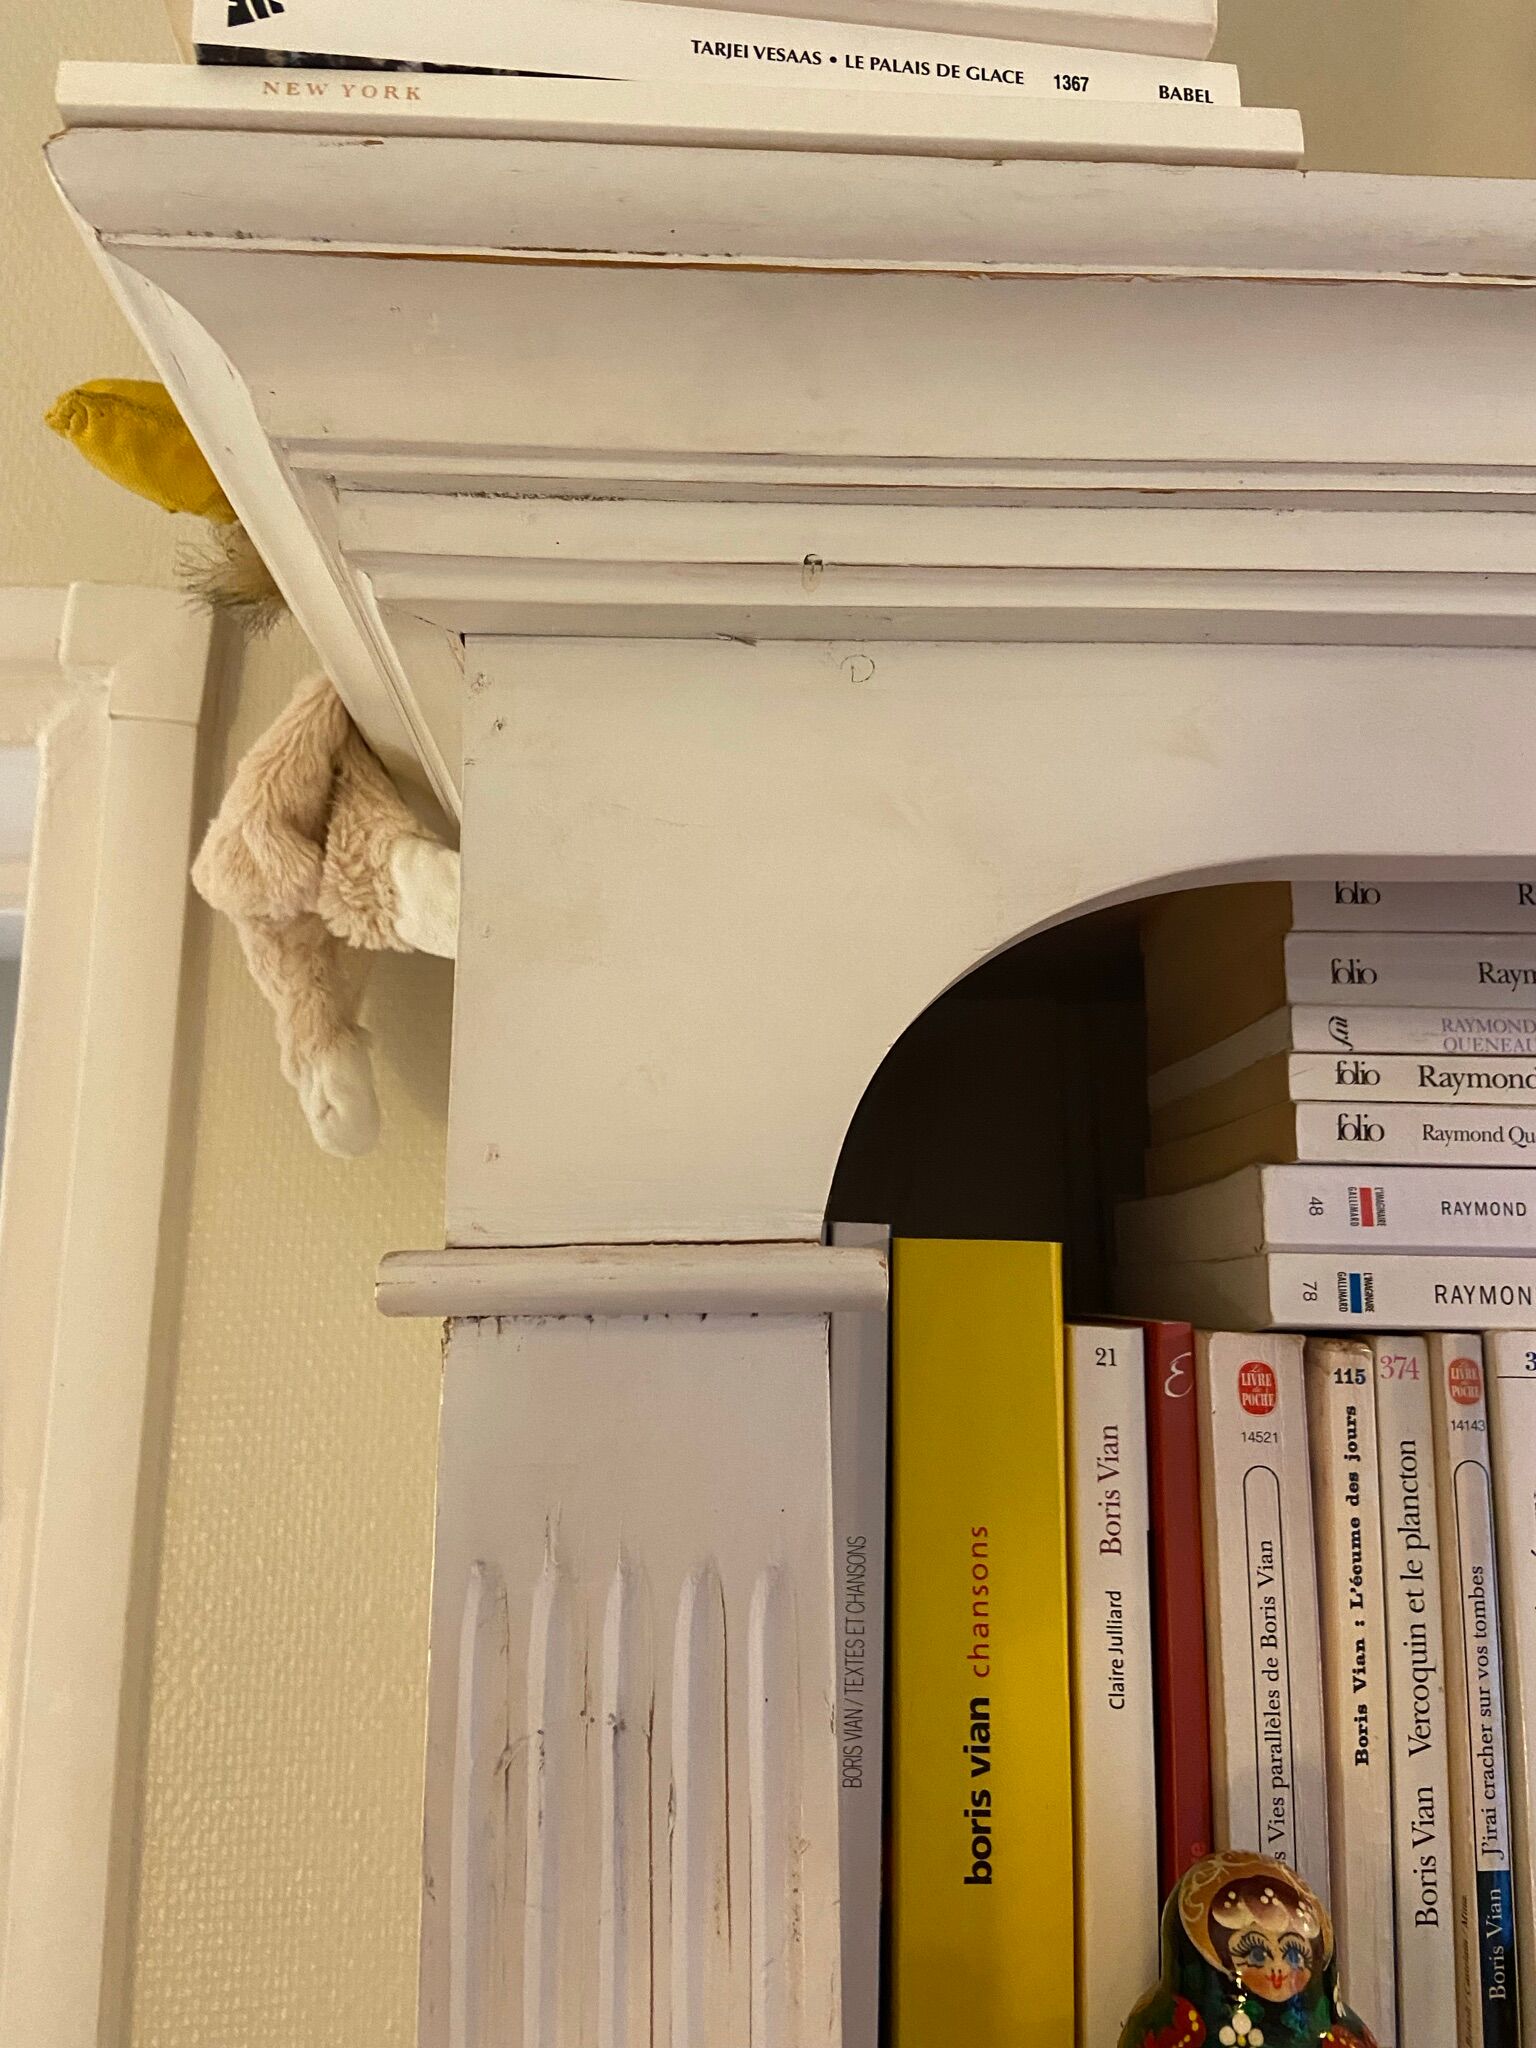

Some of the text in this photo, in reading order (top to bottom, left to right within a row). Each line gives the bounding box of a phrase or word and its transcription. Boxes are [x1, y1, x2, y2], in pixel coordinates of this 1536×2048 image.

[690, 39, 1025, 85] TARJEI VESAAS LE PALAIS DE GLACE
[263, 81, 422, 101] NEW YORK
[1053, 74, 1090, 92] 1367
[1158, 84, 1215, 104] BABEL
[1331, 958, 1378, 985] folio
[1335, 1060, 1381, 1086] folio
[1336, 1113, 1385, 1142] folio
[1422, 1123, 1504, 1147] Raymond
[1308, 1196, 1325, 1217] 48
[1347, 1186, 1360, 1227] GALLIMARD
[1441, 1200, 1527, 1217] RAYMOND
[1302, 1281, 1319, 1302] 78
[1336, 1271, 1349, 1313] GALLIMARD
[1095, 1347, 1118, 1367] 21
[1333, 1367, 1367, 1385] 115
[1380, 1354, 1420, 1381] 374
[1241, 1372, 1272, 1387] LIVRE
[1242, 1392, 1275, 1407] POCHE
[1241, 1431, 1279, 1444] 14521
[1343, 1405, 1361, 1461] jours
[1450, 1419, 1487, 1432] 14143
[1096, 1424, 1122, 1556] Boris Vian
[1346, 1470, 1361, 1507] des
[845, 1535, 867, 1615] CHANSONS
[1257, 1539, 1274, 1589] Vian
[1349, 1516, 1364, 1610] L'écume
[1397, 1438, 1437, 1758] Vercoquin et le plancton
[845, 1617, 866, 1636] ET
[1260, 1595, 1278, 1650] Boris
[843, 1639, 866, 1696] TEXTES
[1105, 1590, 1125, 1710] Claire Julliard
[1261, 1656, 1279, 1682] de
[1353, 1637, 1367, 1694] Vian
[963, 1525, 993, 1885] boris vian chansons
[1467, 1564, 1505, 1862] J'irai cracher sur vos tombes
[843, 1707, 863, 1743] VIAN
[1263, 1689, 1290, 1790] parallèles
[1355, 1703, 1370, 1766] Boris
[842, 1746, 862, 1788] BORIS
[1268, 1796, 1286, 1844] Vies
[1412, 1785, 1439, 1929] Boris Vian
[1486, 1887, 1507, 2001] Boris Vian
